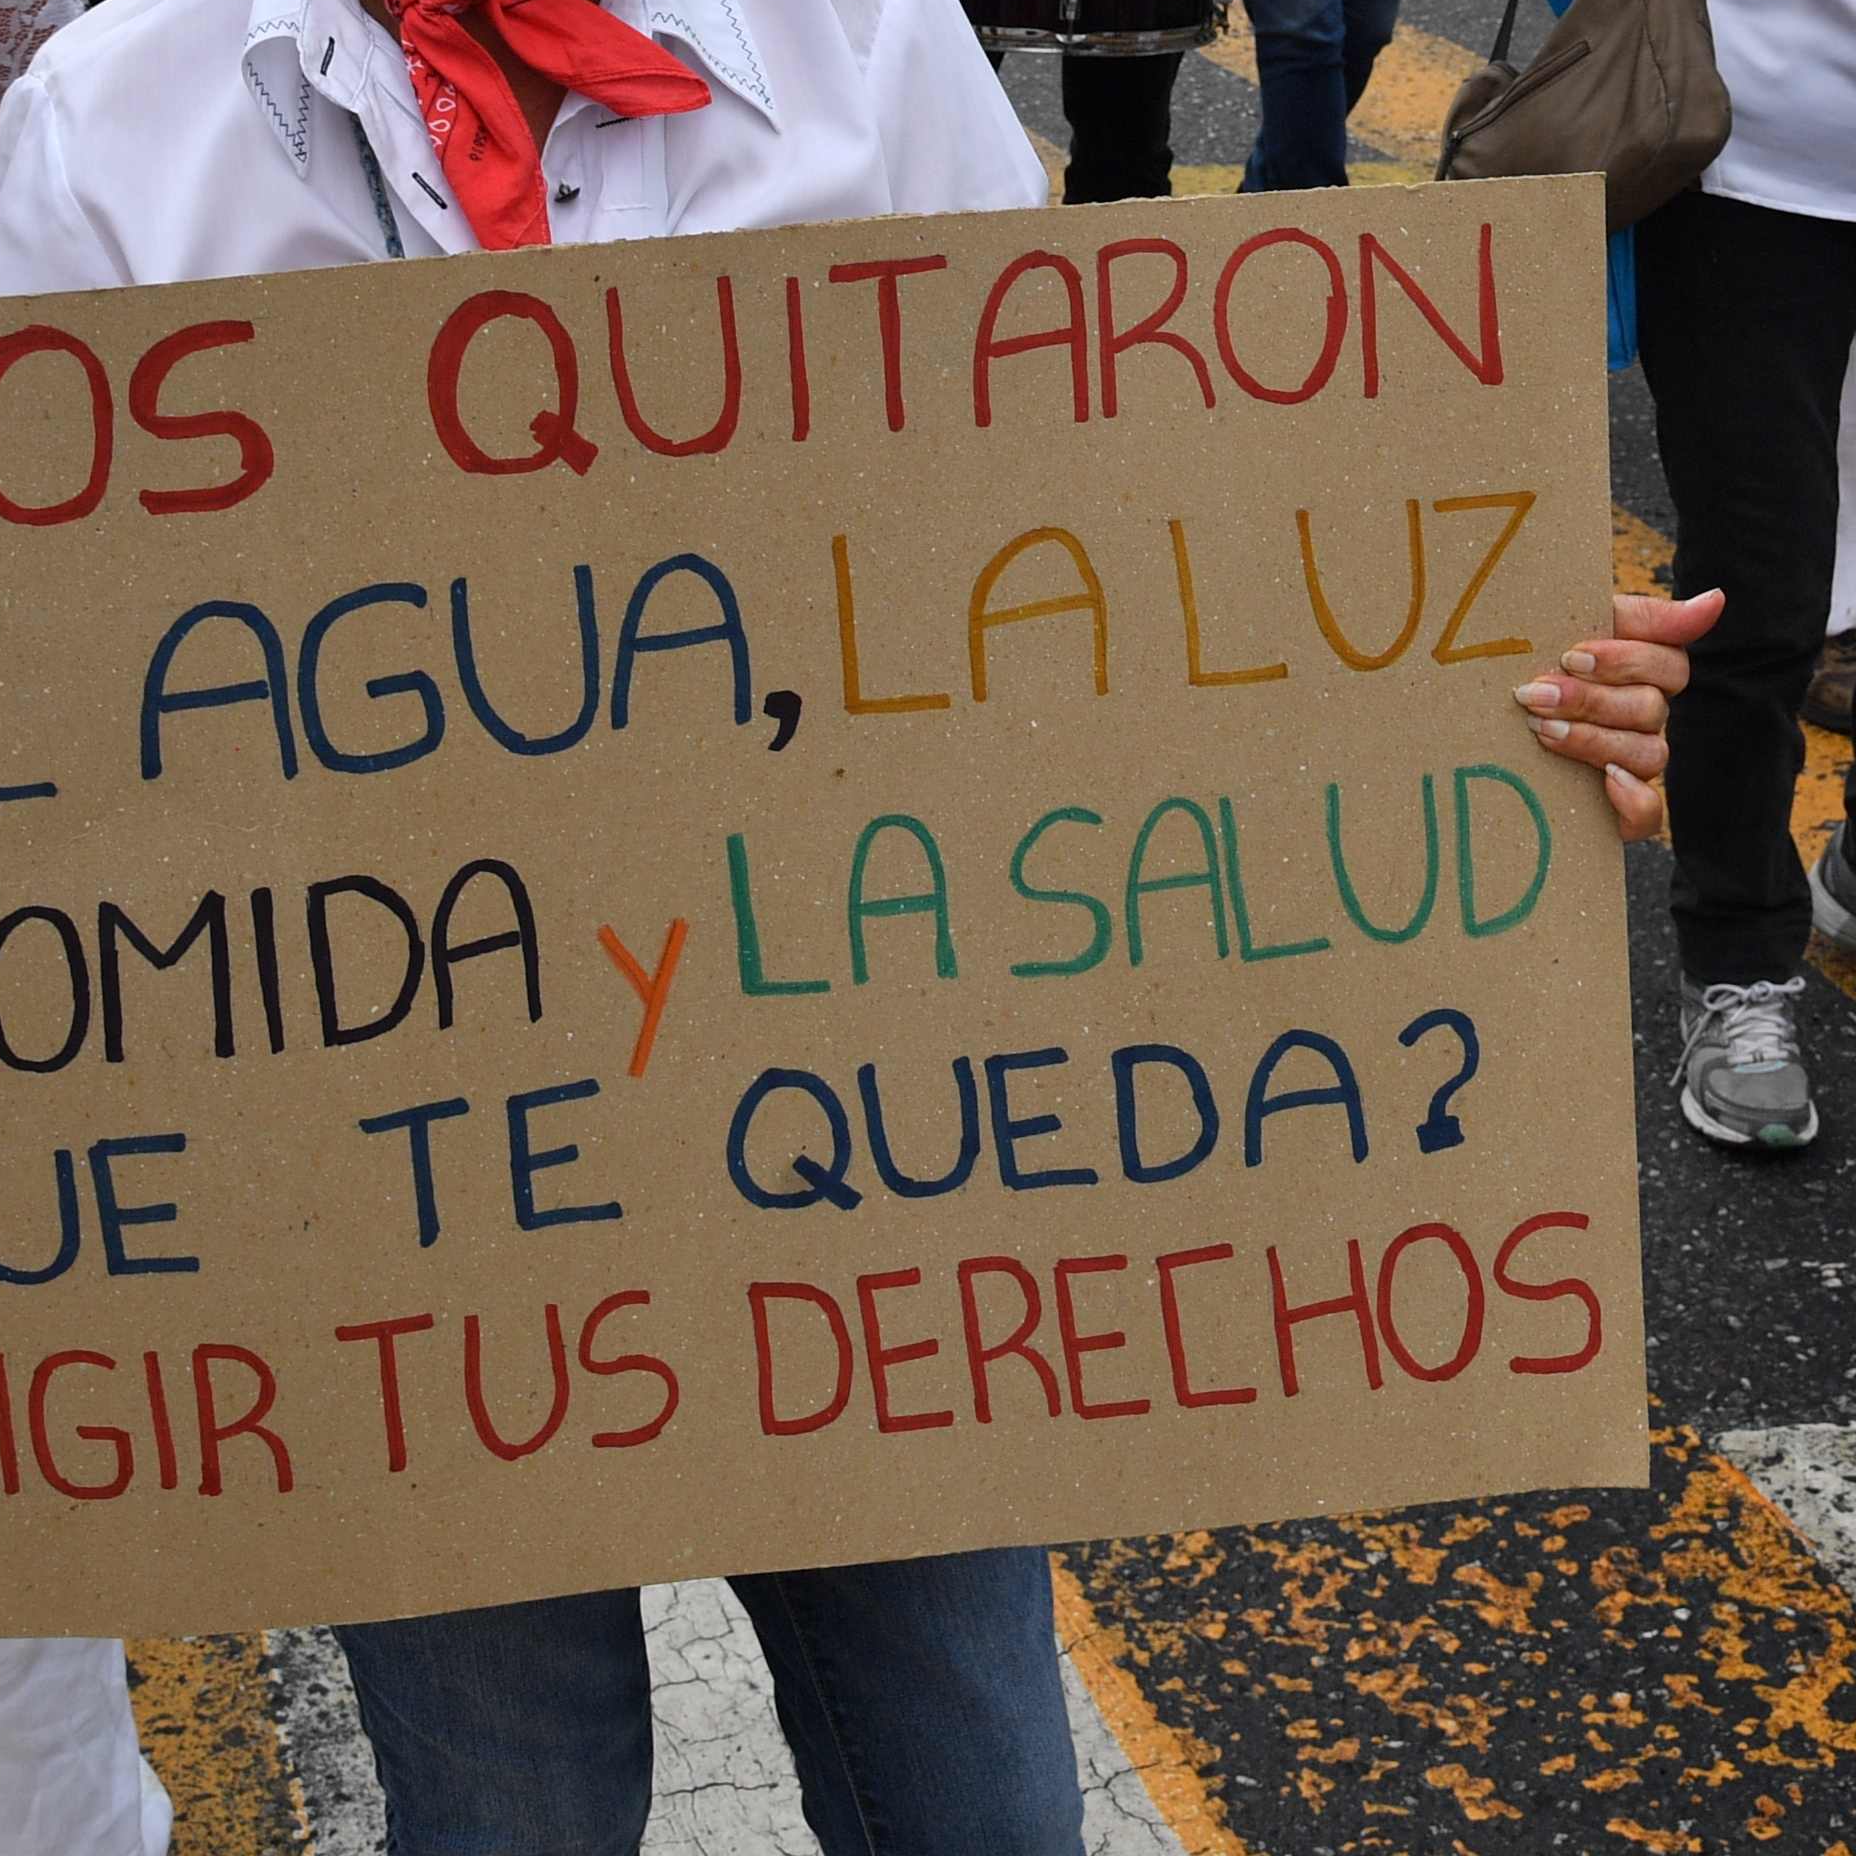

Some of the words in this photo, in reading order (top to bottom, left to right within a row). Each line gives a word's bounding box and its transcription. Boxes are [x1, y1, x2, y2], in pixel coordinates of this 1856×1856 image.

[427, 224, 1504, 476] QUITARON
[140, 553, 802, 781] AGUA,
[832, 527, 1108, 714] LA
[1166, 492, 1537, 687] LUZ
[727, 815, 957, 996] LA
[1010, 766, 1550, 977] SALUD
[358, 1078, 623, 1248] TE
[726, 1008, 1479, 1211] QUEDA?
[334, 1282, 679, 1473] TUS
[747, 1212, 1601, 1436] DERECHOS
